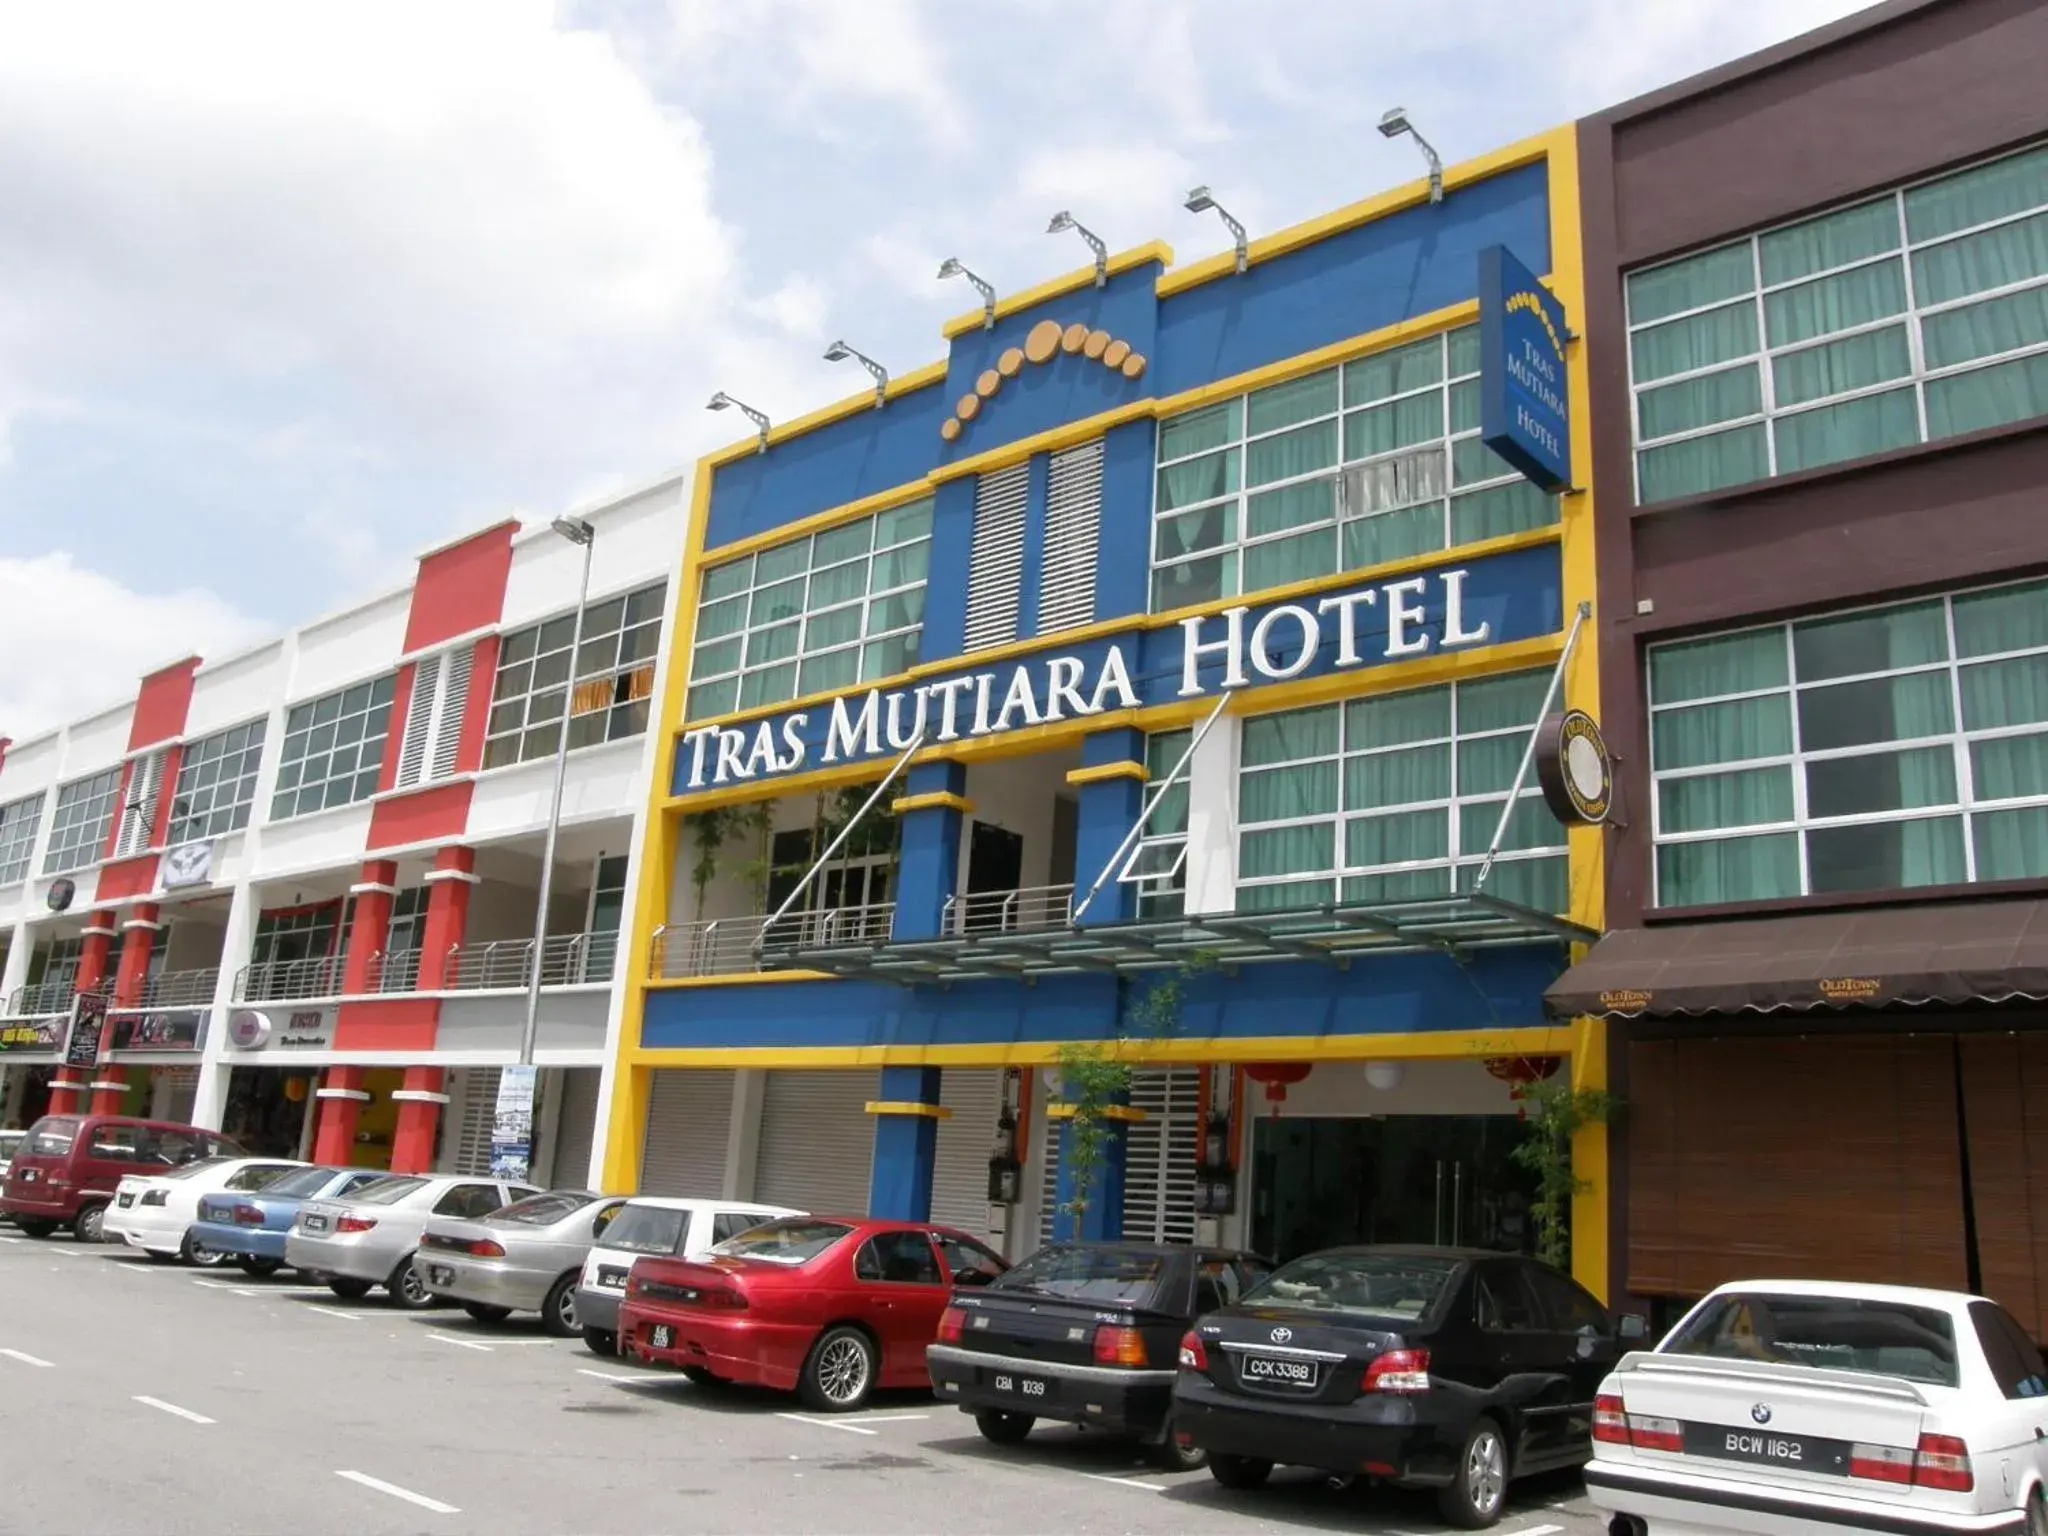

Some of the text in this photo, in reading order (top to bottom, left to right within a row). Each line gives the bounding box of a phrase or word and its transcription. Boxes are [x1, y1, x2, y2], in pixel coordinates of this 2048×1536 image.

[1522, 338, 1556, 383] TRAS
[1507, 352, 1567, 422] MUTIARA
[1517, 404, 1560, 459] HOTEL
[683, 569, 1491, 788] TRAS MUTIARA HOTEL
[1251, 1359, 1309, 1379] CCK 3388
[1725, 1433, 1802, 1460] BCW 1162
